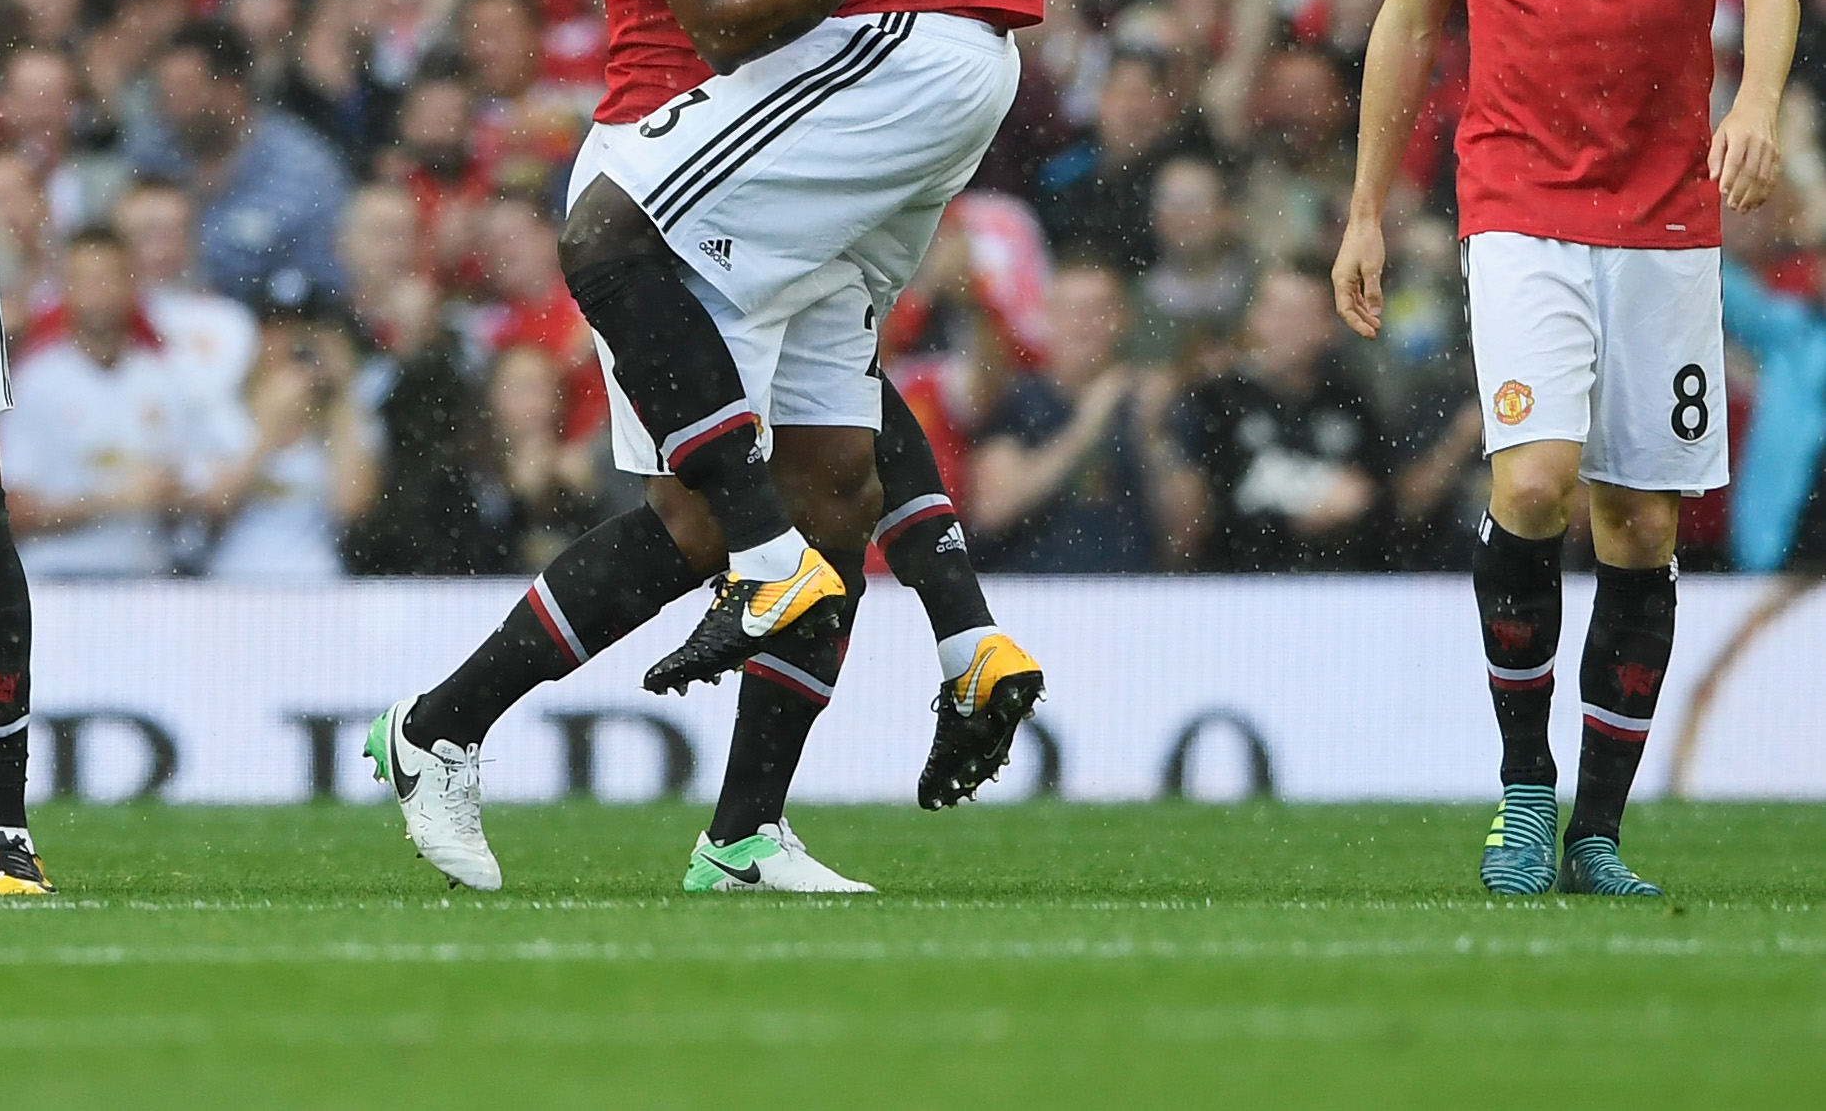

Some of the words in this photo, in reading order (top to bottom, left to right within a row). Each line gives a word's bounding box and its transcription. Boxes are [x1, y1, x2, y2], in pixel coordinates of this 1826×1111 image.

[639, 88, 711, 138] 3
[698, 239, 732, 272] adidas
[1671, 363, 1708, 440] 8
